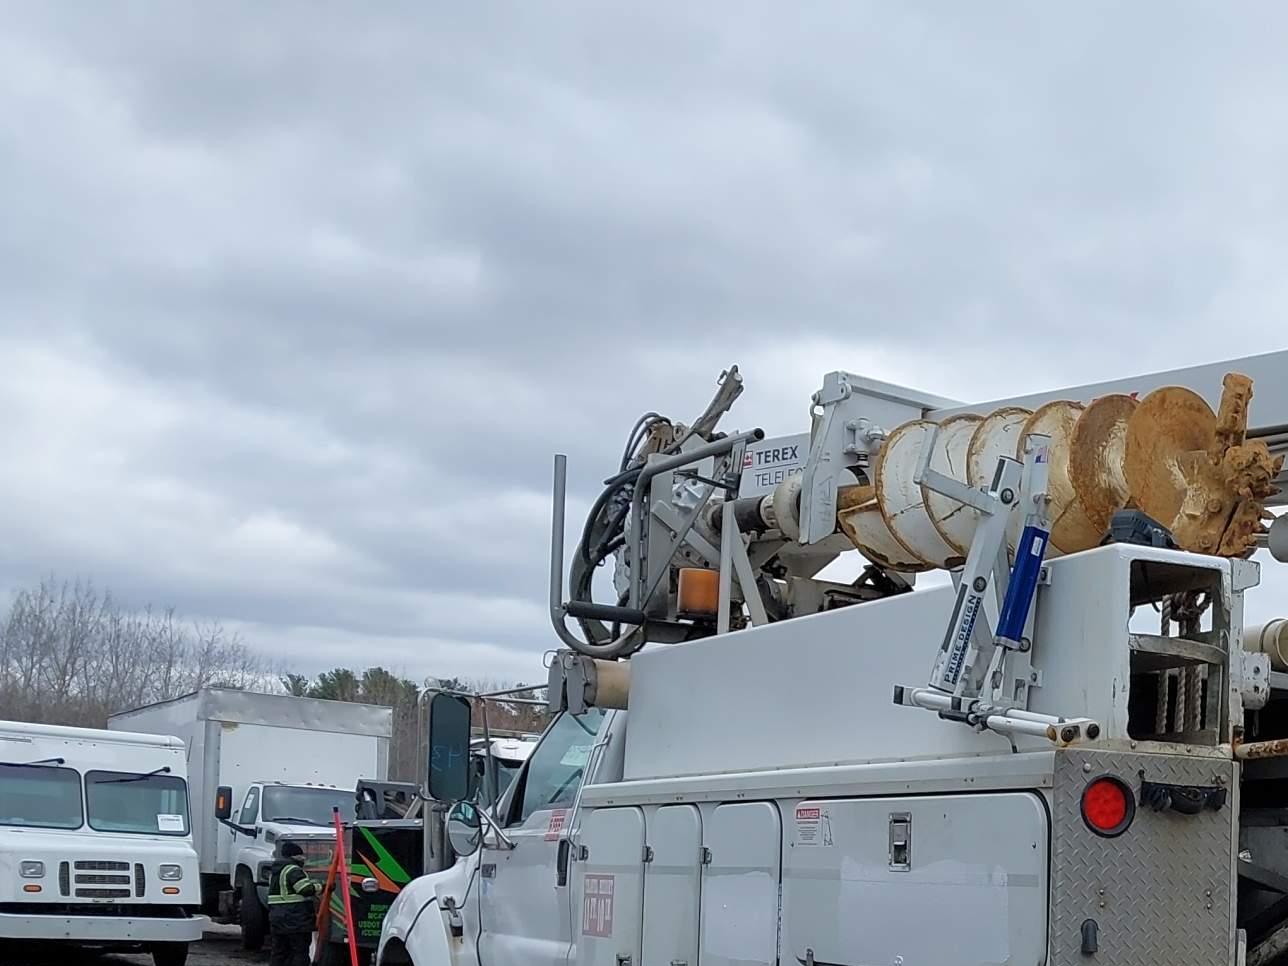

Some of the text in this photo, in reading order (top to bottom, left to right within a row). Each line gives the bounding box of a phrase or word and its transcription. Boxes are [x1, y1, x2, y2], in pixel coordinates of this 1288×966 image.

[756, 445, 798, 465] TEREX
[944, 644, 962, 683] PRIME
[958, 594, 977, 641] DESIGN
